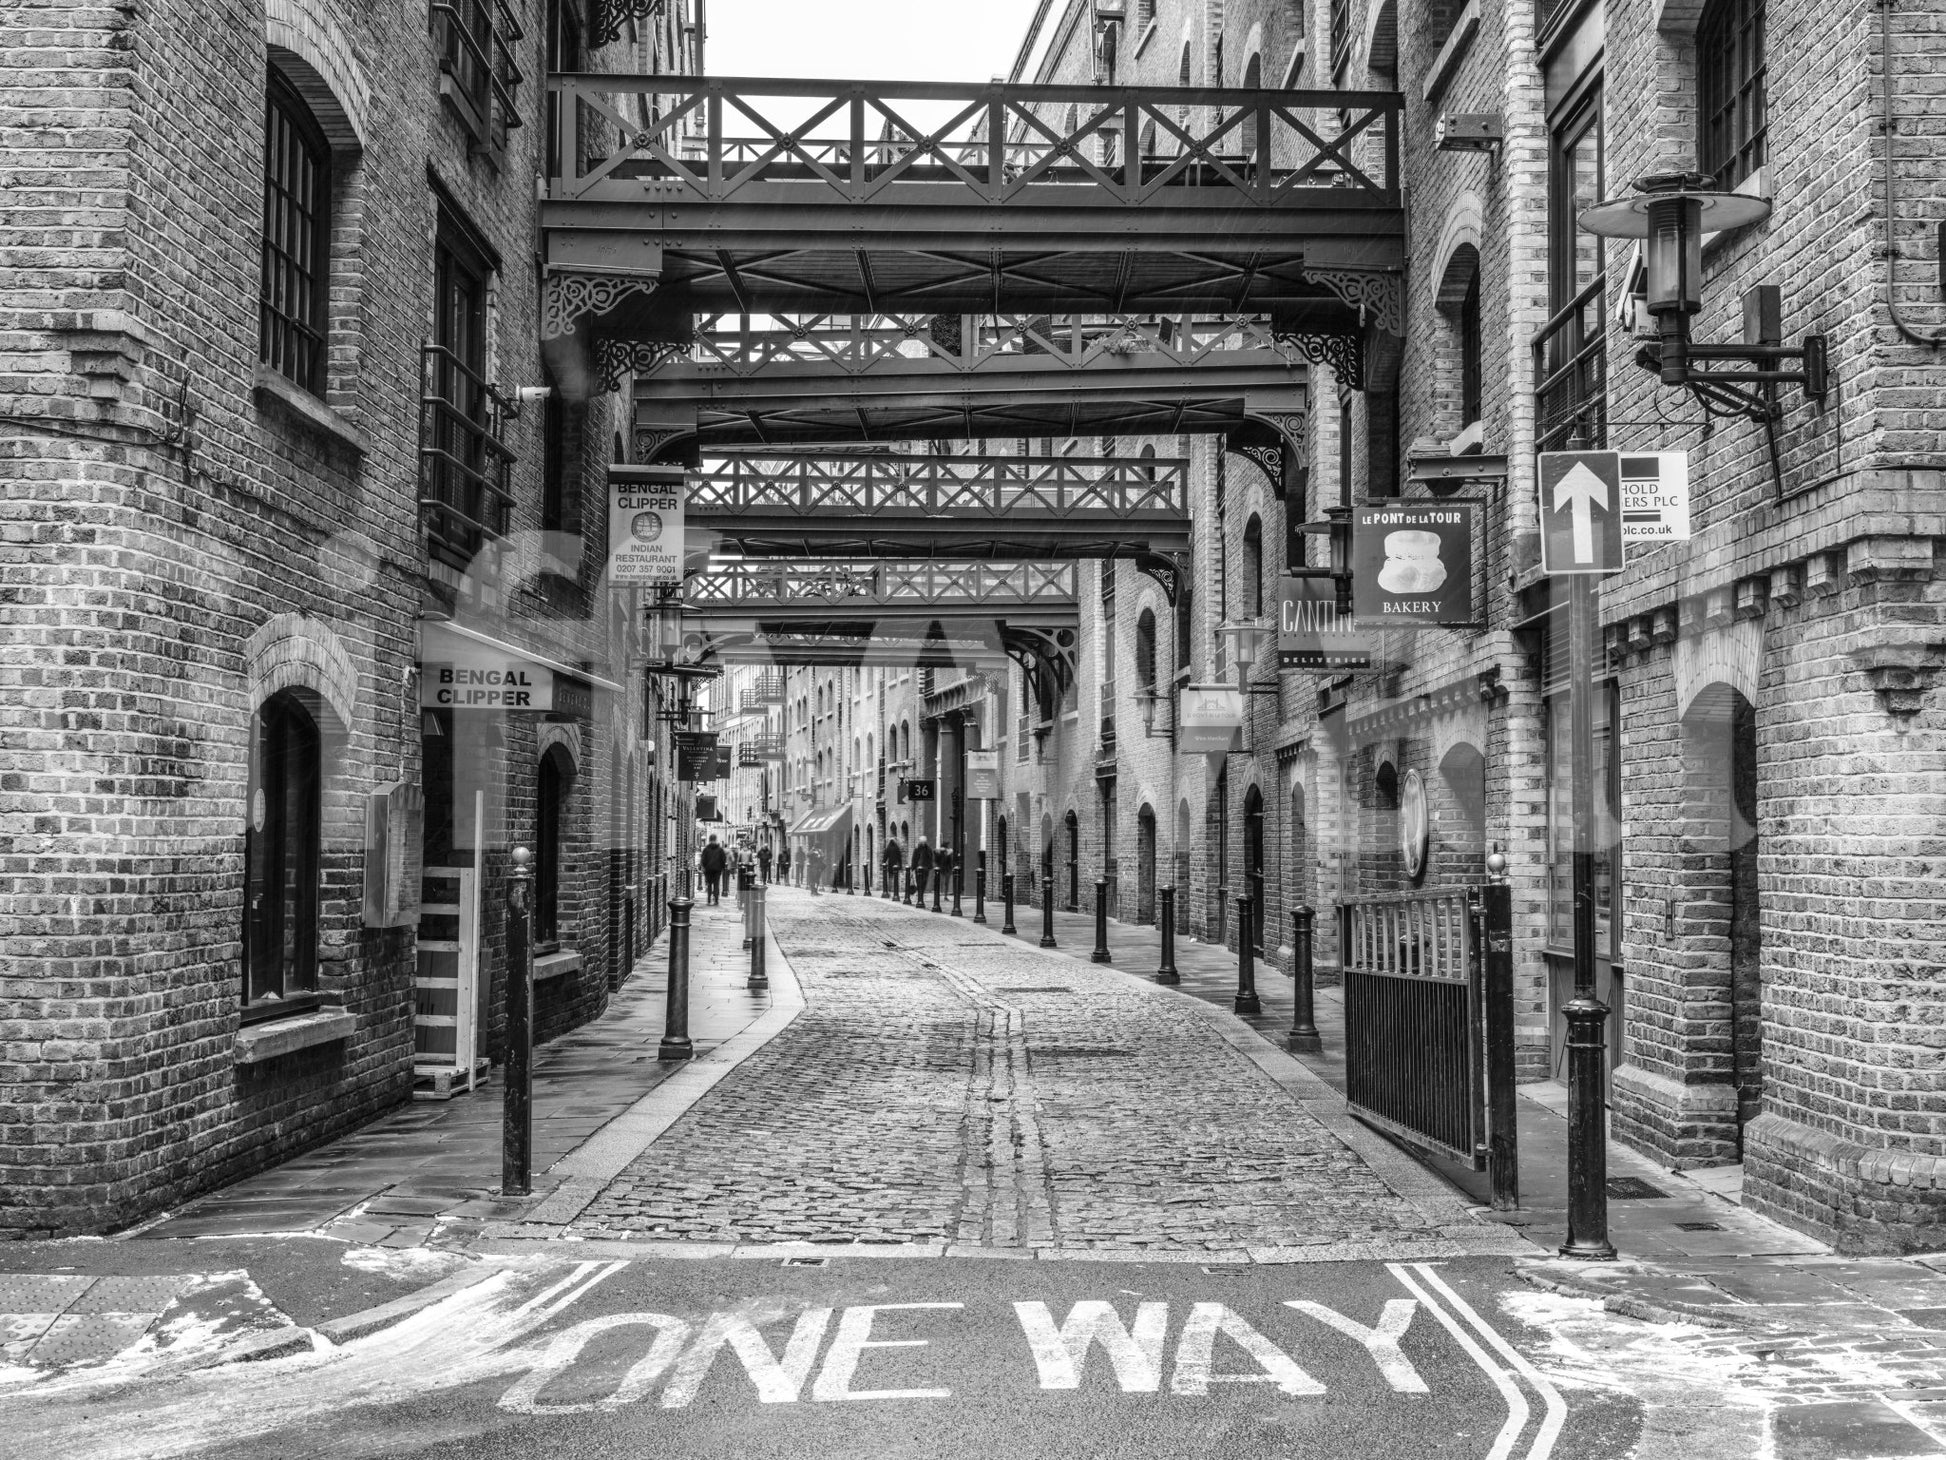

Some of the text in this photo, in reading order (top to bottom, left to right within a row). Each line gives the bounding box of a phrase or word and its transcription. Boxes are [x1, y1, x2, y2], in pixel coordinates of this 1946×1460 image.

[618, 484, 677, 494] BENGAL
[617, 497, 677, 510] CLIPPER
[1654, 495, 1678, 506] PLC
[1362, 512, 1461, 525] LE PONT DE LA TOUR
[631, 545, 662, 553] INDIAN
[615, 555, 677, 563] RESTAURANT
[616, 565, 676, 574] 0207 357 9001
[1383, 601, 1442, 613] BAKERY
[1283, 600, 1356, 633] CANTIN
[439, 668, 532, 687] BENGAL
[437, 688, 531, 707] CLIPPER
[915, 785, 929, 796] 36
[497, 1299, 1431, 1414] ONE WAY
